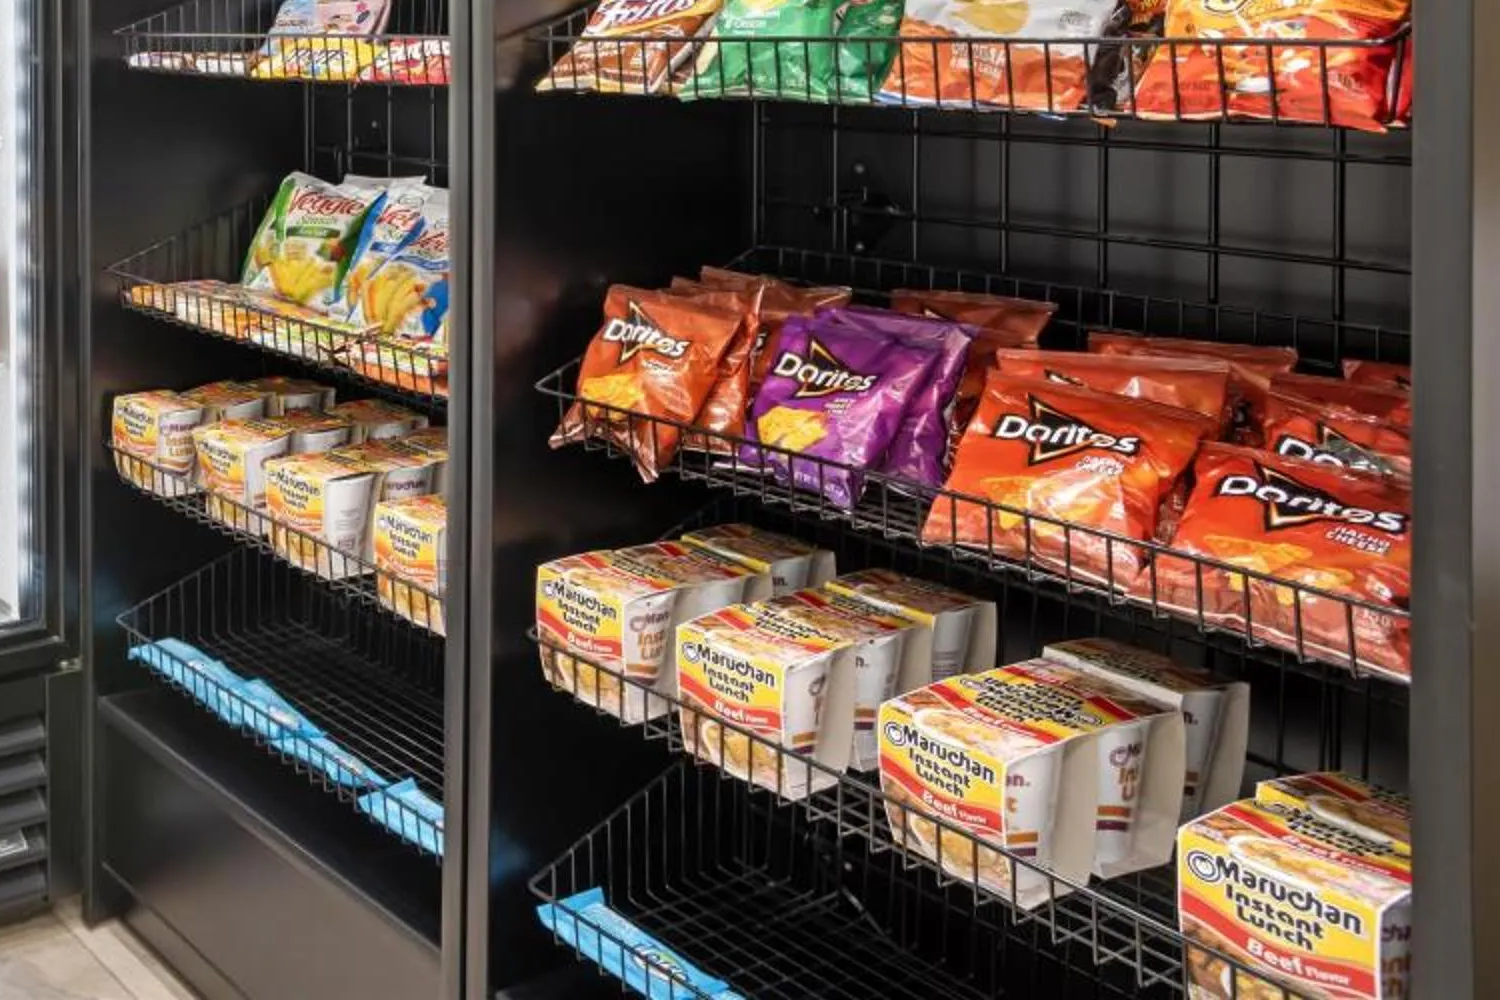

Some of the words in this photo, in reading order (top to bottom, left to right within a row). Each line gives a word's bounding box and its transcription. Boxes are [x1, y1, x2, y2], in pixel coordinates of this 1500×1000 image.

[603, 318, 692, 357] Doritos
[774, 351, 878, 391] Doritos
[995, 415, 1141, 454] Doritos
[1220, 475, 1406, 532] Doritos
[553, 580, 617, 620] Maruchan
[696, 643, 776, 687] Maruchan
[702, 664, 755, 695] Instant
[708, 680, 750, 704] Lunch
[903, 724, 996, 785] Maruchan
[908, 747, 971, 790] Instant
[914, 767, 965, 800] Lunch
[922, 789, 959, 820] Beef
[1216, 856, 1363, 936] Maruchan
[1225, 884, 1324, 940] Instant
[1236, 904, 1314, 954] Lunch
[1246, 936, 1303, 977] Beef
